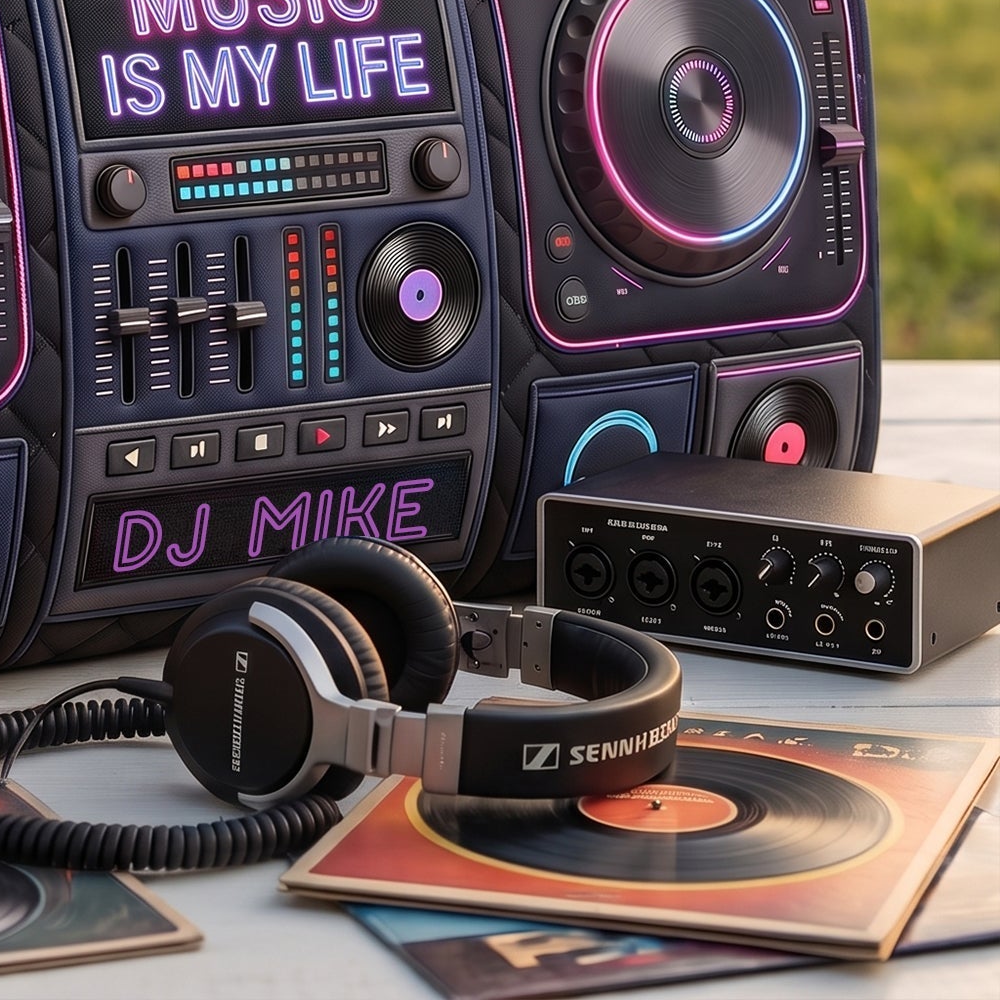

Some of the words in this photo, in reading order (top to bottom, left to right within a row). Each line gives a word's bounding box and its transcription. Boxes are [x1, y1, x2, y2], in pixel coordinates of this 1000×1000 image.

[101, 53, 165, 116] IS
[182, 43, 277, 110] MY
[298, 33, 430, 102] LIFE
[113, 503, 211, 573] DJ
[248, 478, 434, 558] MIKE
